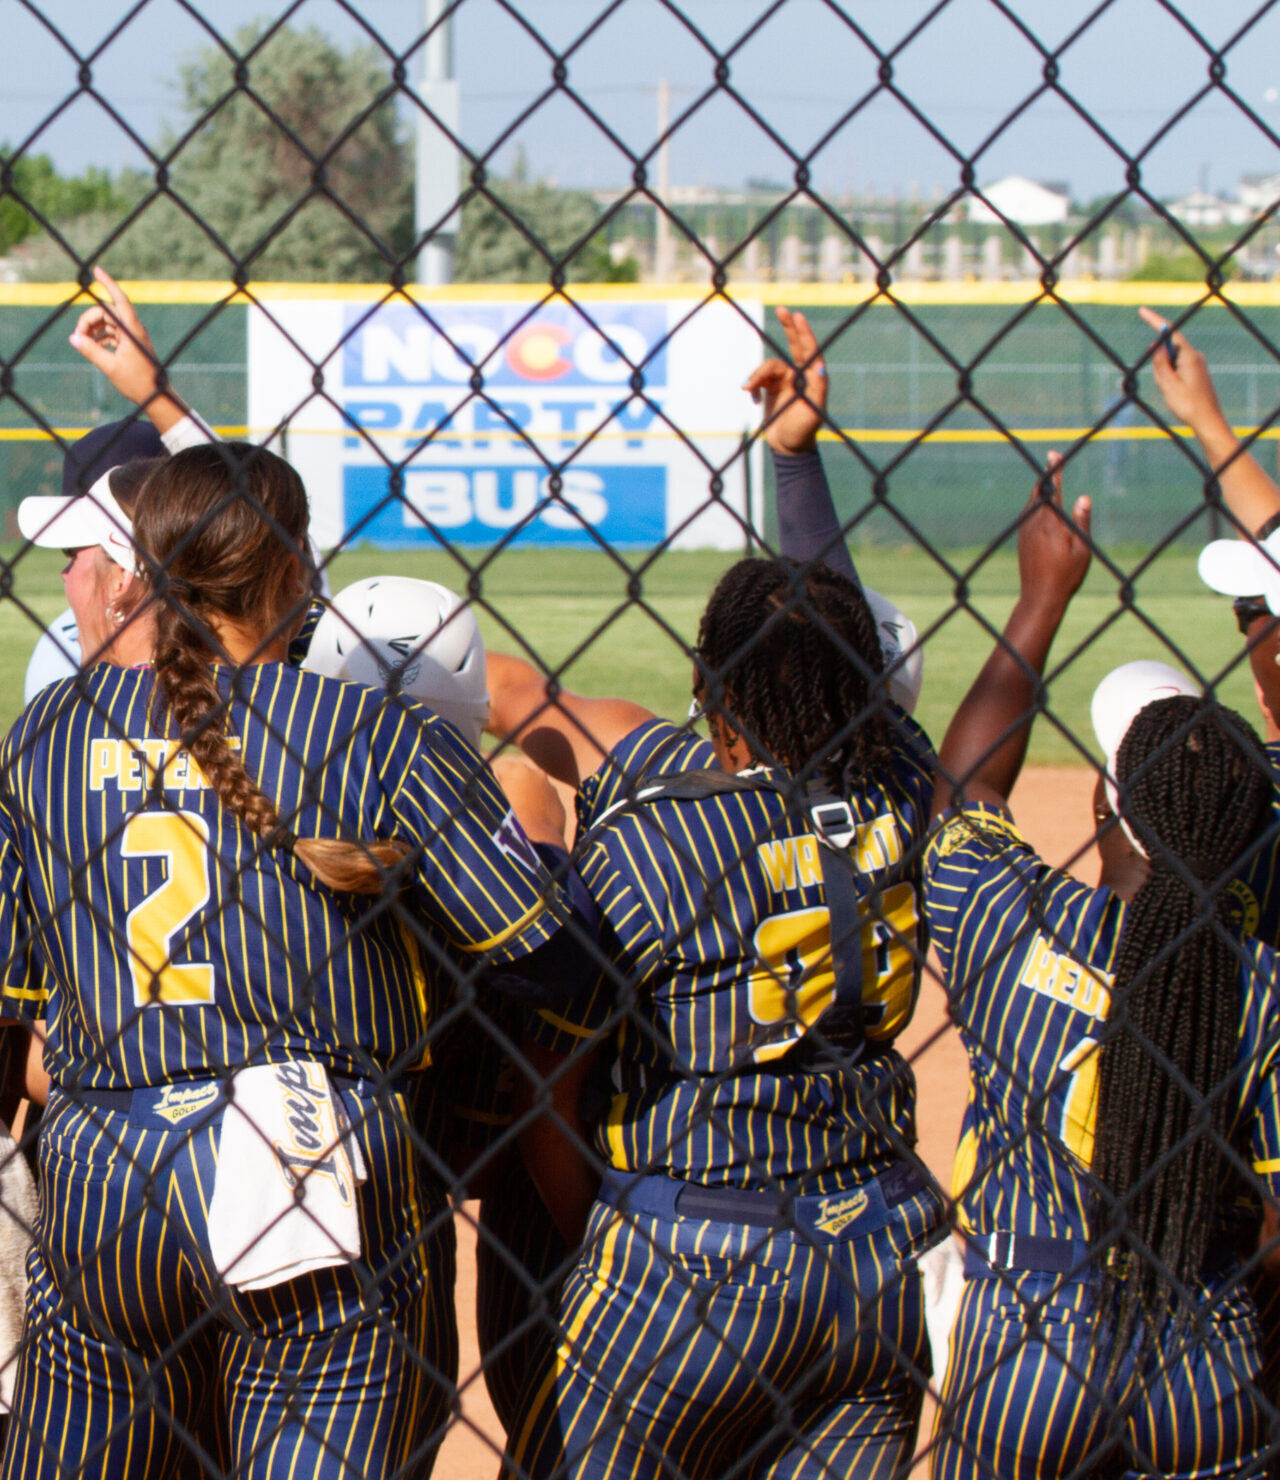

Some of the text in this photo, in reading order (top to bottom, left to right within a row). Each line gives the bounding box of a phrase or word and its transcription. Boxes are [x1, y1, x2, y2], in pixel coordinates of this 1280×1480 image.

[361, 323, 648, 384] NOCO
[343, 399, 667, 450] PARTY
[401, 469, 610, 530] BUS
[90, 736, 241, 791] PETER
[757, 813, 901, 893] WRHT
[121, 811, 215, 1007] 2
